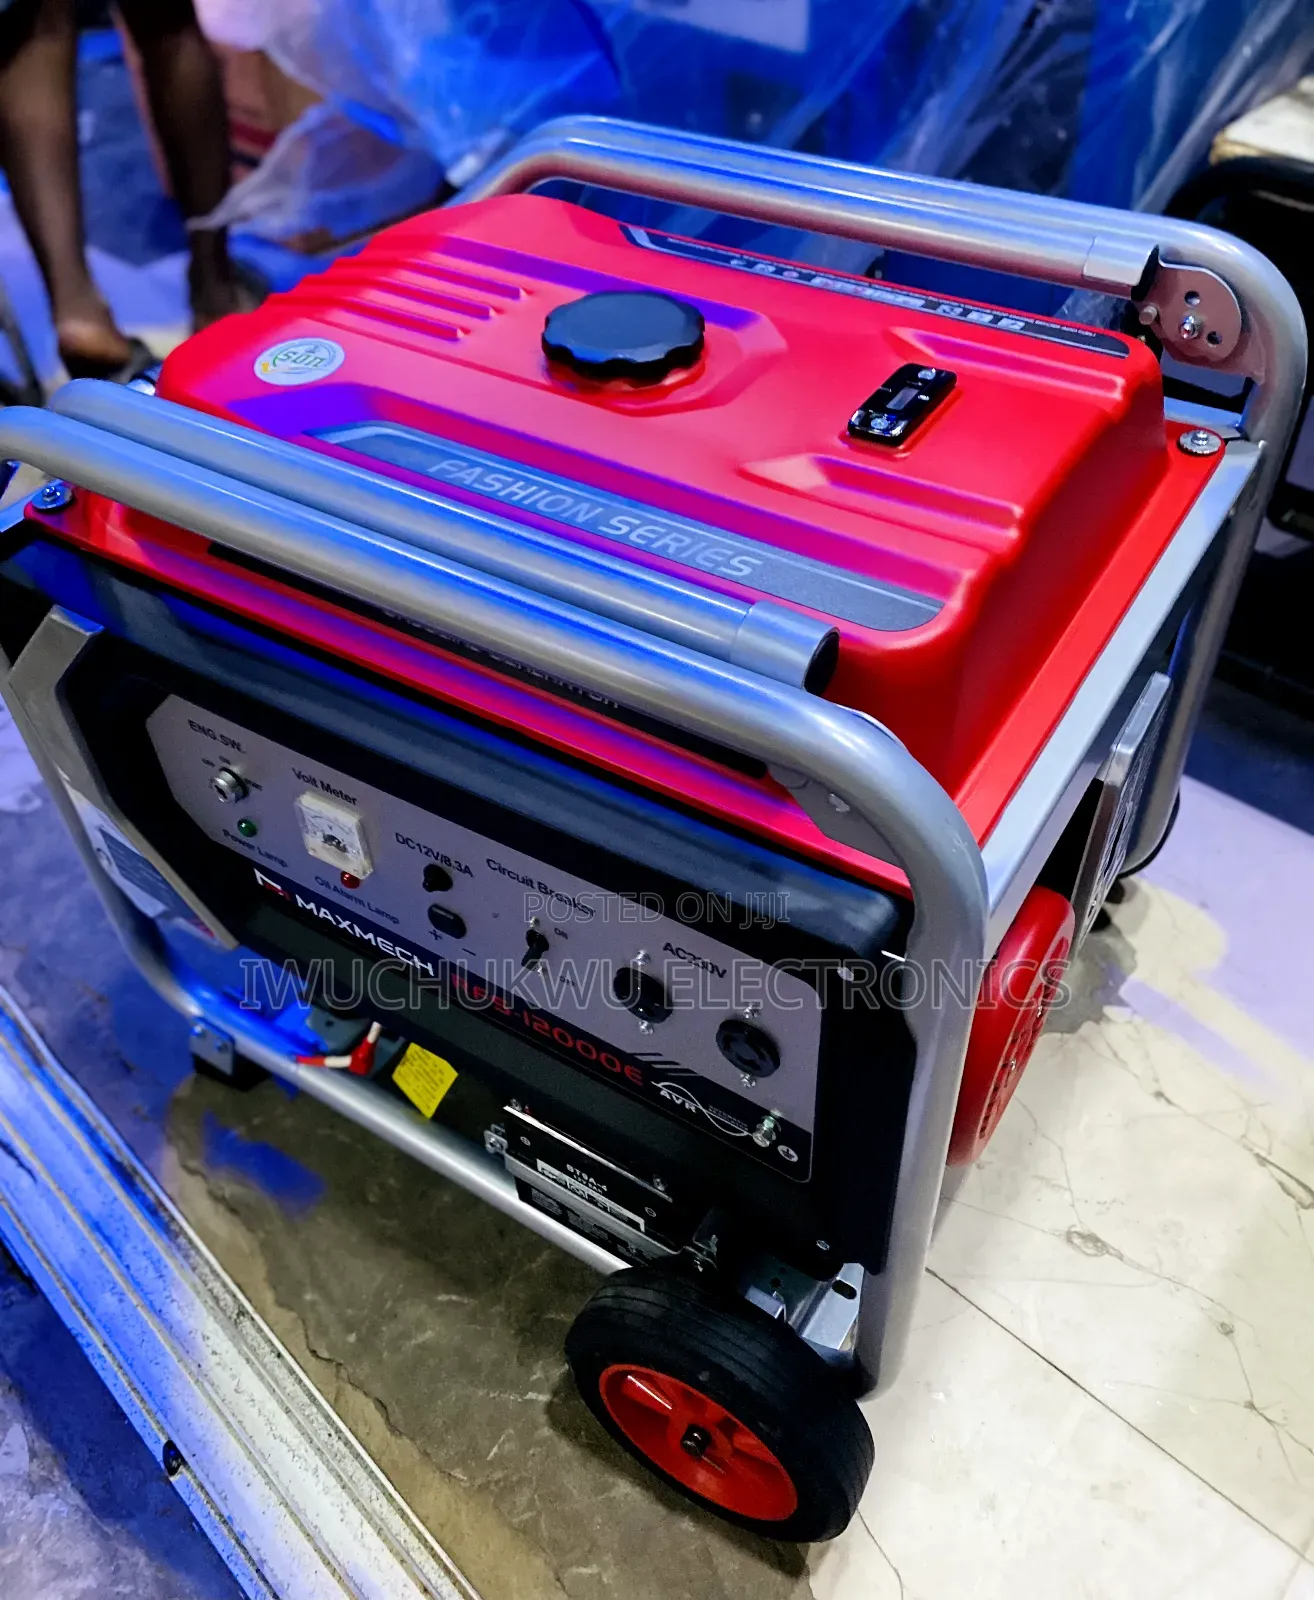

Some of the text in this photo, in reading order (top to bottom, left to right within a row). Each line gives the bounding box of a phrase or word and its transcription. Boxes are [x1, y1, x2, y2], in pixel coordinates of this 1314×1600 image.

[427, 459, 764, 577] FASHION SERIES
[291, 767, 318, 788] Volt
[320, 780, 358, 806] Meter
[222, 829, 288, 868] Power Lamp
[394, 832, 475, 878] DC12V/8.3A
[332, 885, 366, 907] Alarm
[367, 902, 400, 925] Lamp
[485, 857, 597, 917] Circuit Breaker
[295, 893, 435, 977] MAXMECH
[662, 941, 728, 979] AC230V
[659, 1089, 697, 1114] AVR
